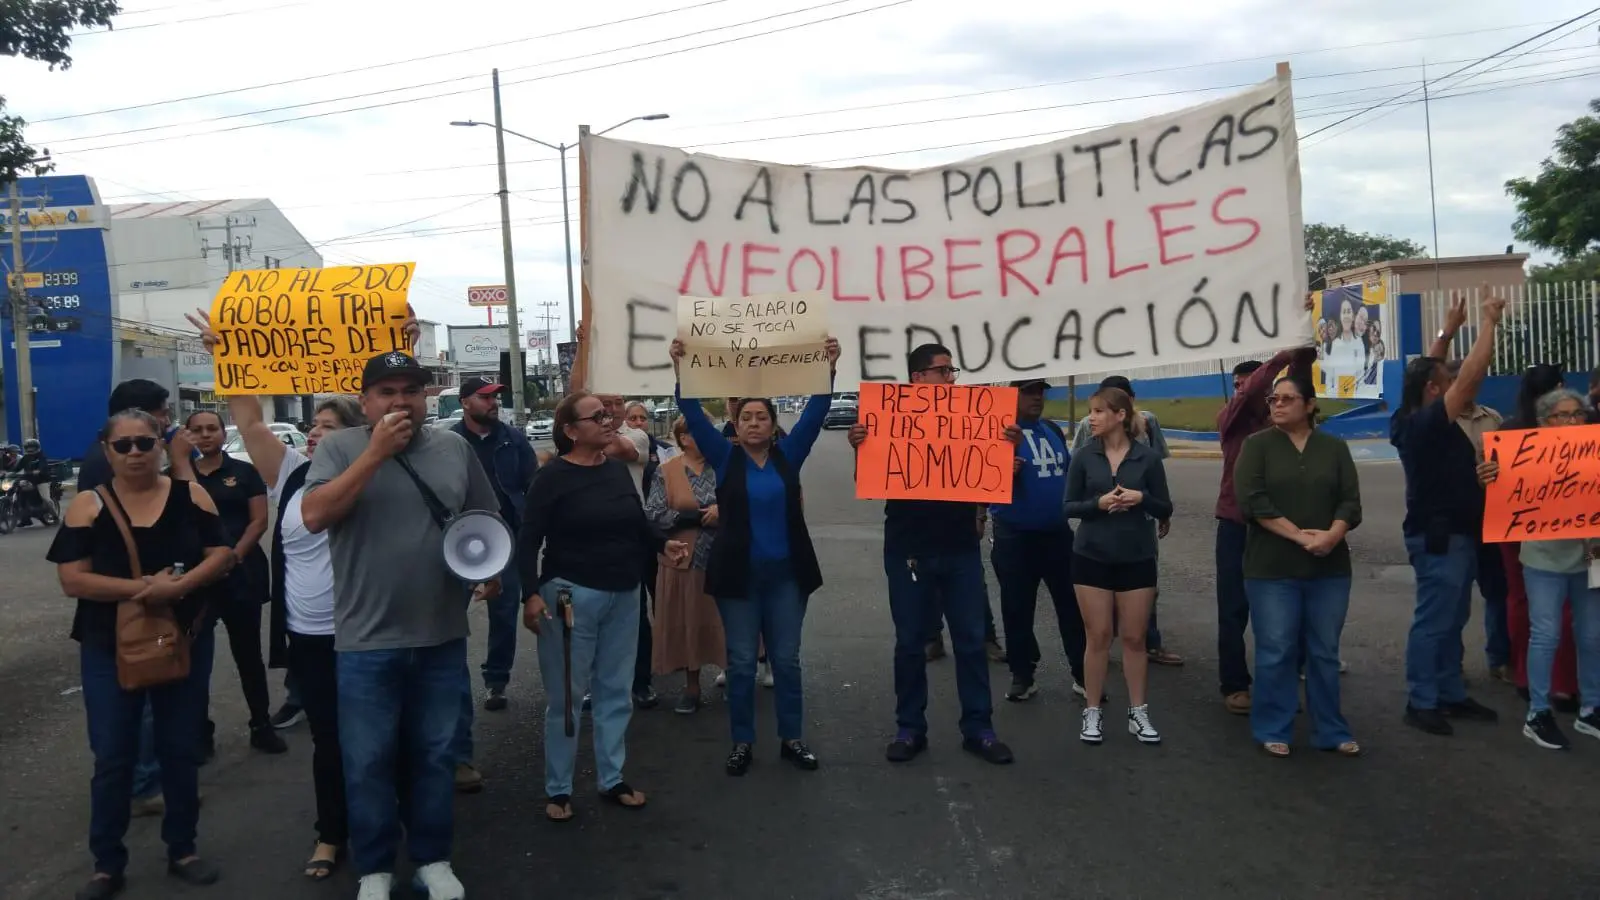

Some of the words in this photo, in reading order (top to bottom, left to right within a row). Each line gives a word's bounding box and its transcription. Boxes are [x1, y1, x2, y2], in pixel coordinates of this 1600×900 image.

[620, 151, 711, 222] NO
[733, 167, 780, 235] A
[804, 171, 917, 225] LAS
[941, 98, 1280, 221] POLITICAS
[235, 270, 279, 293] NO
[289, 270, 324, 293] AL
[469, 289, 507, 301] OXXO
[307, 295, 324, 325] A
[693, 300, 720, 318] EL
[729, 300, 807, 318] SALARIO
[218, 327, 335, 359] JADORES
[349, 327, 384, 354] DE
[390, 326, 412, 351] LA
[626, 297, 675, 370] E
[690, 322, 716, 337] NO
[721, 322, 746, 334] SE
[753, 319, 795, 333] TOCA
[691, 354, 702, 368] A
[708, 355, 727, 369] LA
[881, 384, 995, 416] RESPETO
[865, 412, 878, 437] A
[890, 414, 926, 439] LAS
[936, 414, 1013, 441] PLAZAS
[1022, 429, 1064, 478] LA
